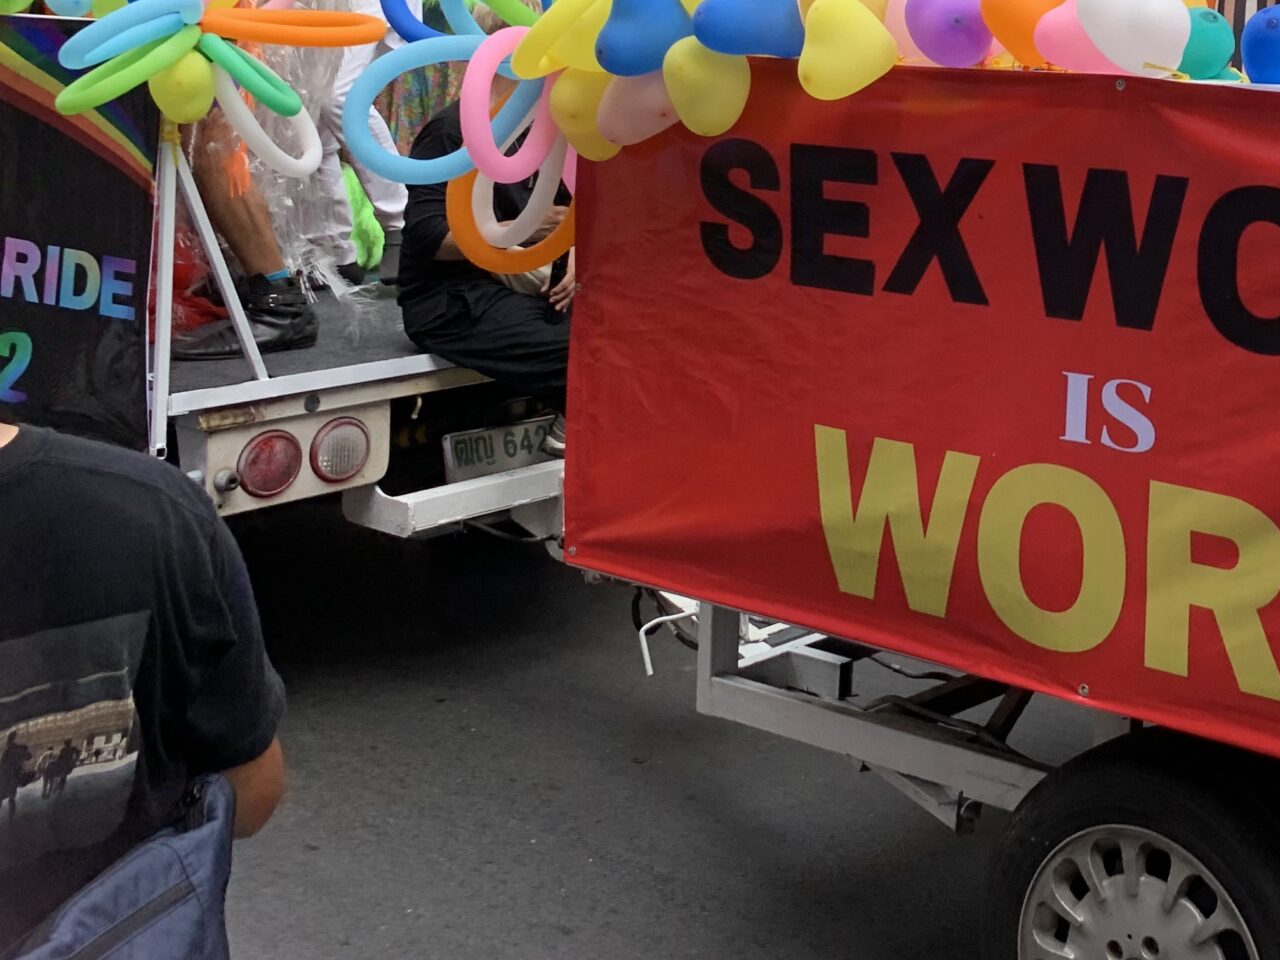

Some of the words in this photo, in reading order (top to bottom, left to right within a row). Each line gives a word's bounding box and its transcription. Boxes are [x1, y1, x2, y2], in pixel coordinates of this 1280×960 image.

[700, 138, 996, 307] SEX
[1, 236, 137, 321] RIDE
[503, 424, 552, 458] 642
[1059, 371, 1156, 453] IS
